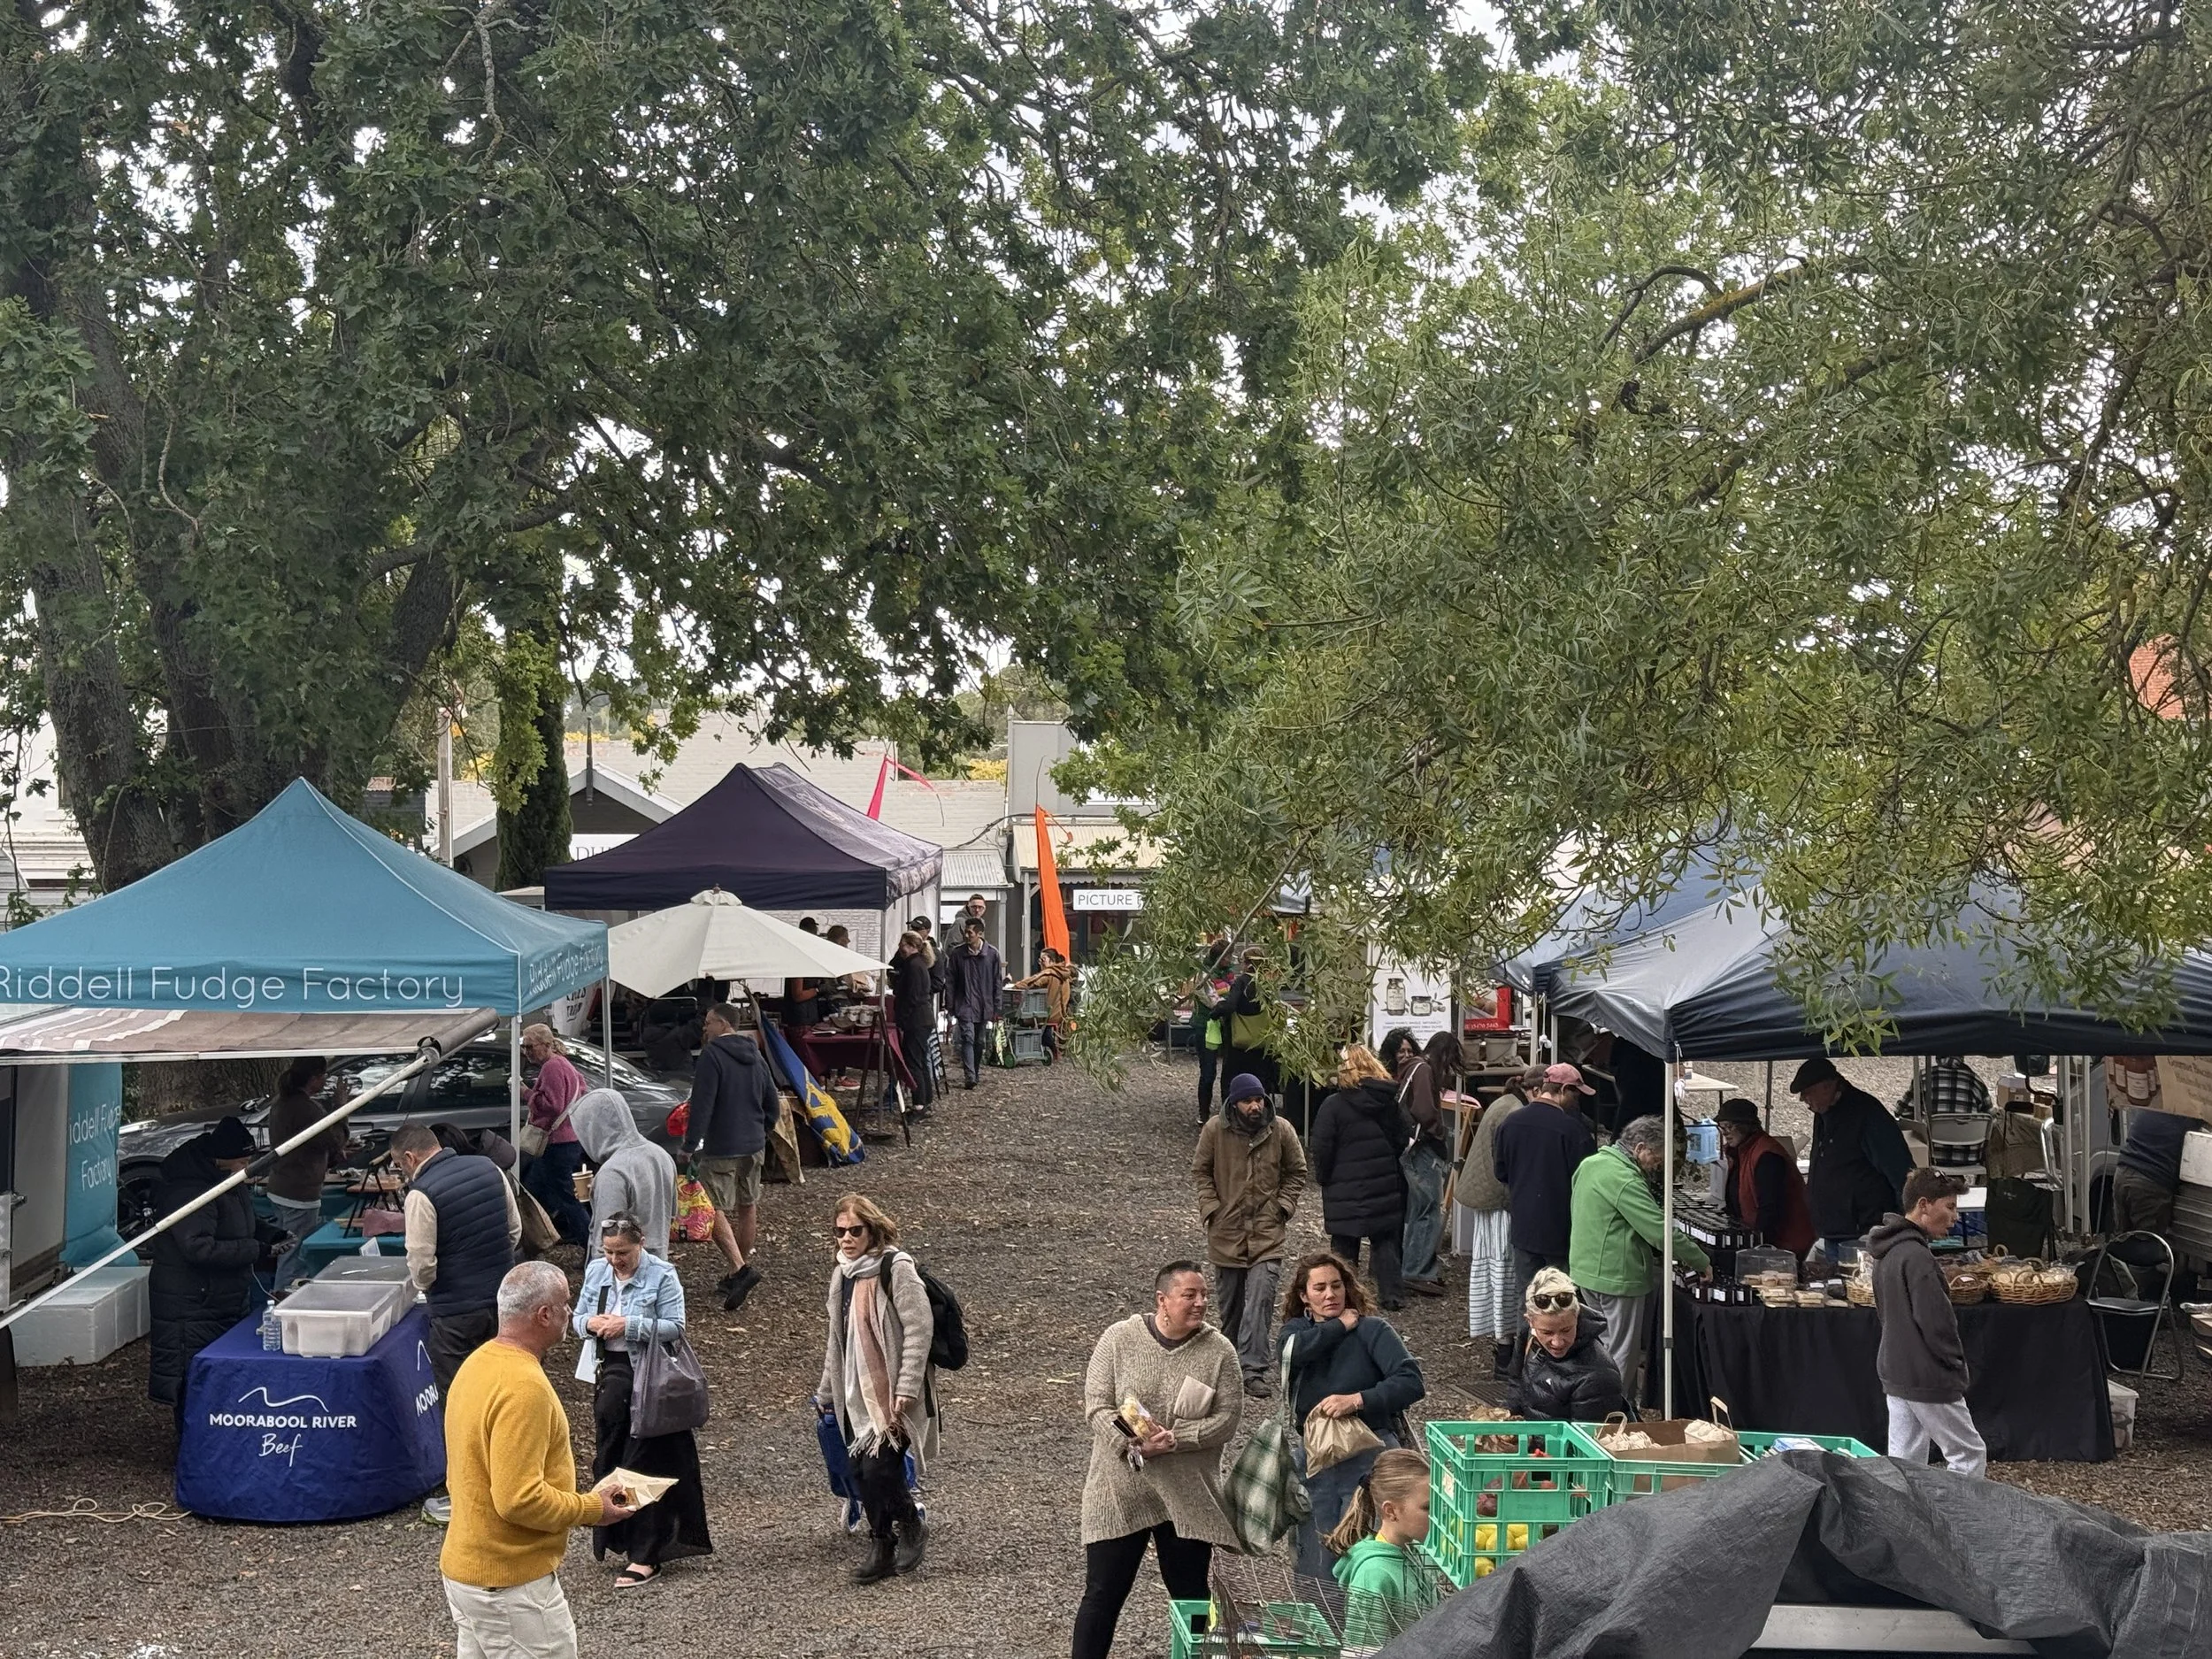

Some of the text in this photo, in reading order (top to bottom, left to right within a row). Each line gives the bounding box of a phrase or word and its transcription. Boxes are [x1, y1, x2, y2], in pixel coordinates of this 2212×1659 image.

[1078, 895, 1133, 905] PICTURE
[0, 965, 463, 1009] Riddell Fudge Factory
[69, 1107, 100, 1146] iddell
[416, 1382, 439, 1417] OOR
[209, 1413, 357, 1429] MOORABOOL RIVER
[258, 1433, 303, 1467] Beef
